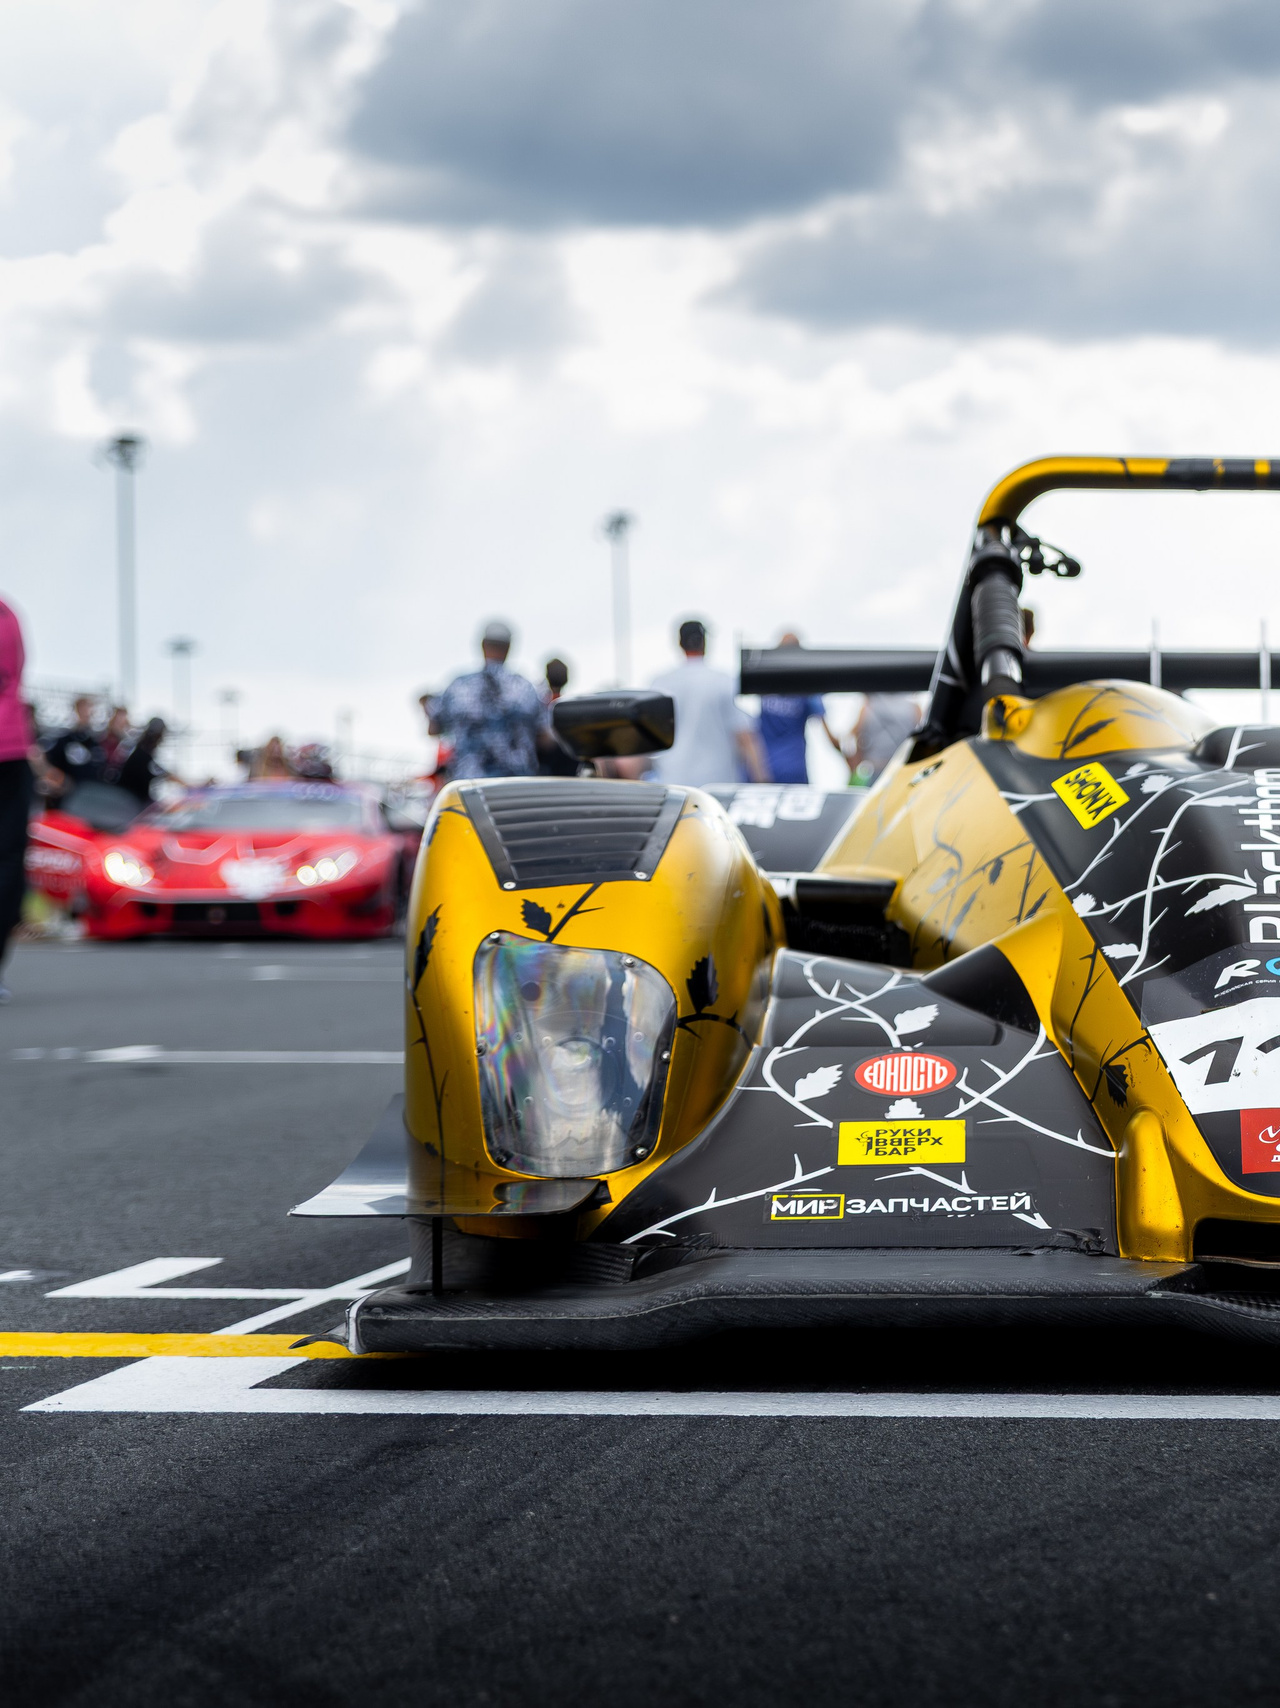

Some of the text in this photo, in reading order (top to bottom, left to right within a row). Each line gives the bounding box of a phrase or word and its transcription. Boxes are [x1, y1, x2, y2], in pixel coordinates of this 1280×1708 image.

[863, 1056, 948, 1092] ЮНОСТЬ
[875, 1128, 932, 1137] РУКИ
[874, 1147, 917, 1156] БАР
[771, 1192, 1031, 1215] МИР ЗАПЧАСТЕЙ
